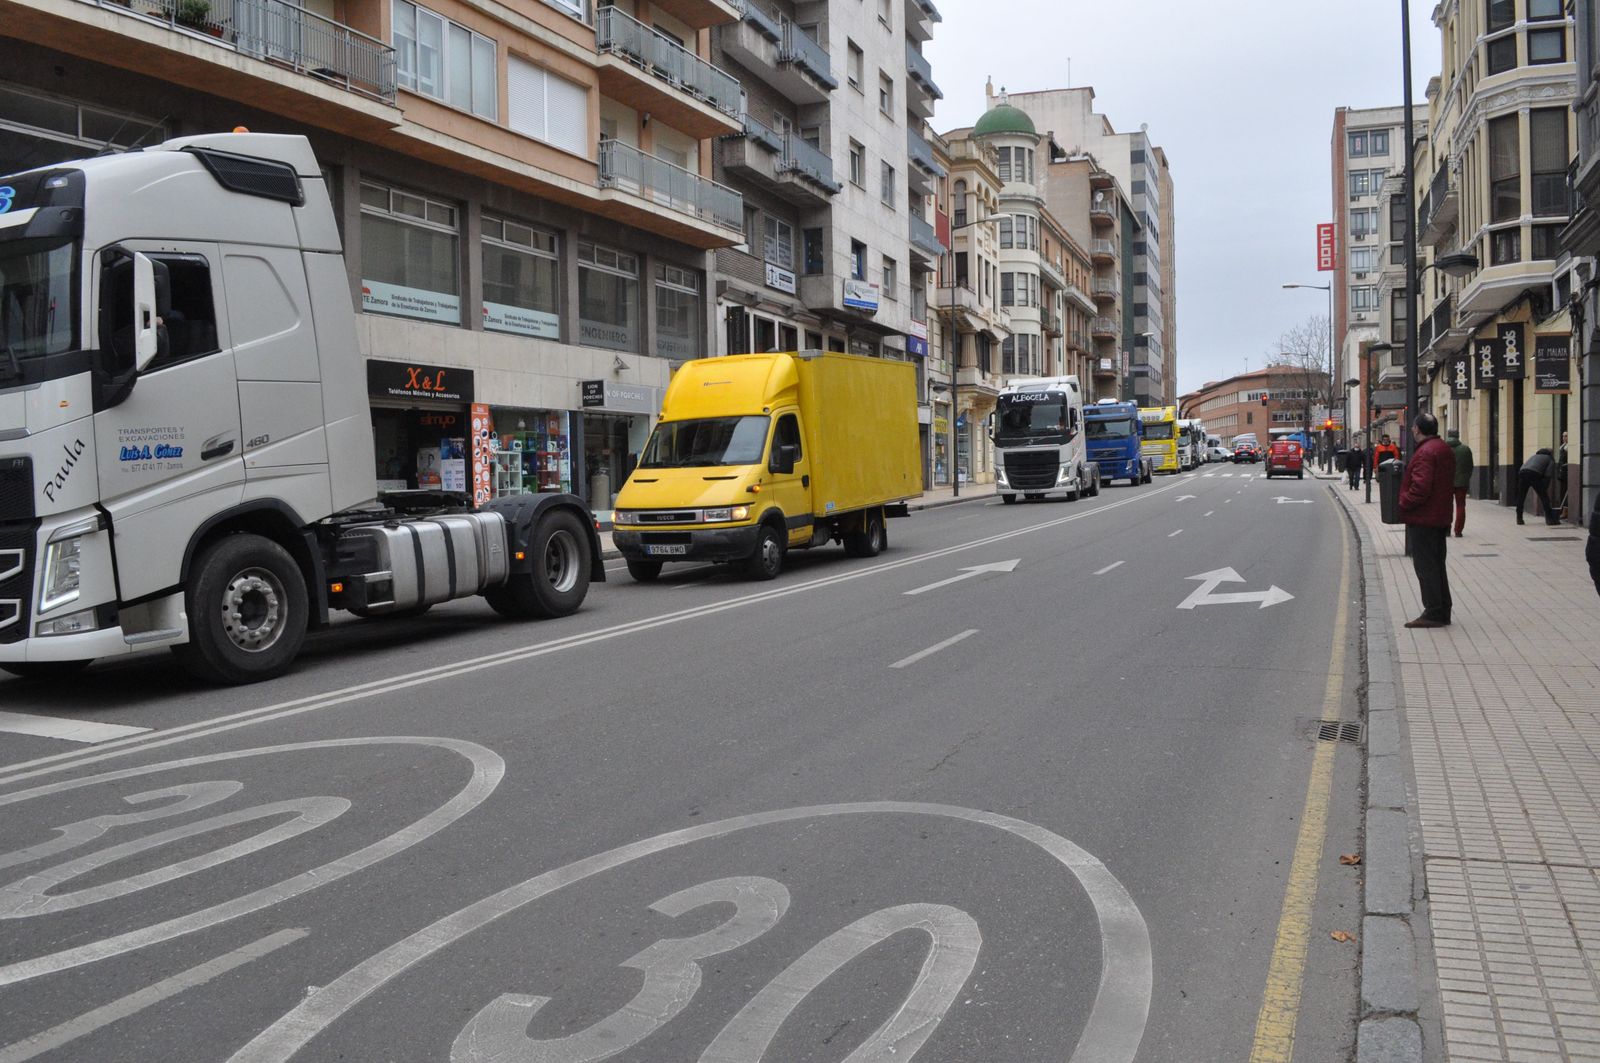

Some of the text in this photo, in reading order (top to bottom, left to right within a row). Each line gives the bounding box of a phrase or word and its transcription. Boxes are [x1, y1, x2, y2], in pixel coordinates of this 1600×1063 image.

[1320, 226, 1331, 267] CCOO
[371, 296, 389, 306] Zamora
[405, 367, 446, 391] X & L
[388, 387, 412, 396] Teléfonos
[118, 426, 180, 435] TRANSPORTES
[118, 434, 185, 442] EXCAVACIONES
[246, 434, 269, 447] 460
[43, 438, 85, 502] Paula
[450, 876, 983, 1063] 30
